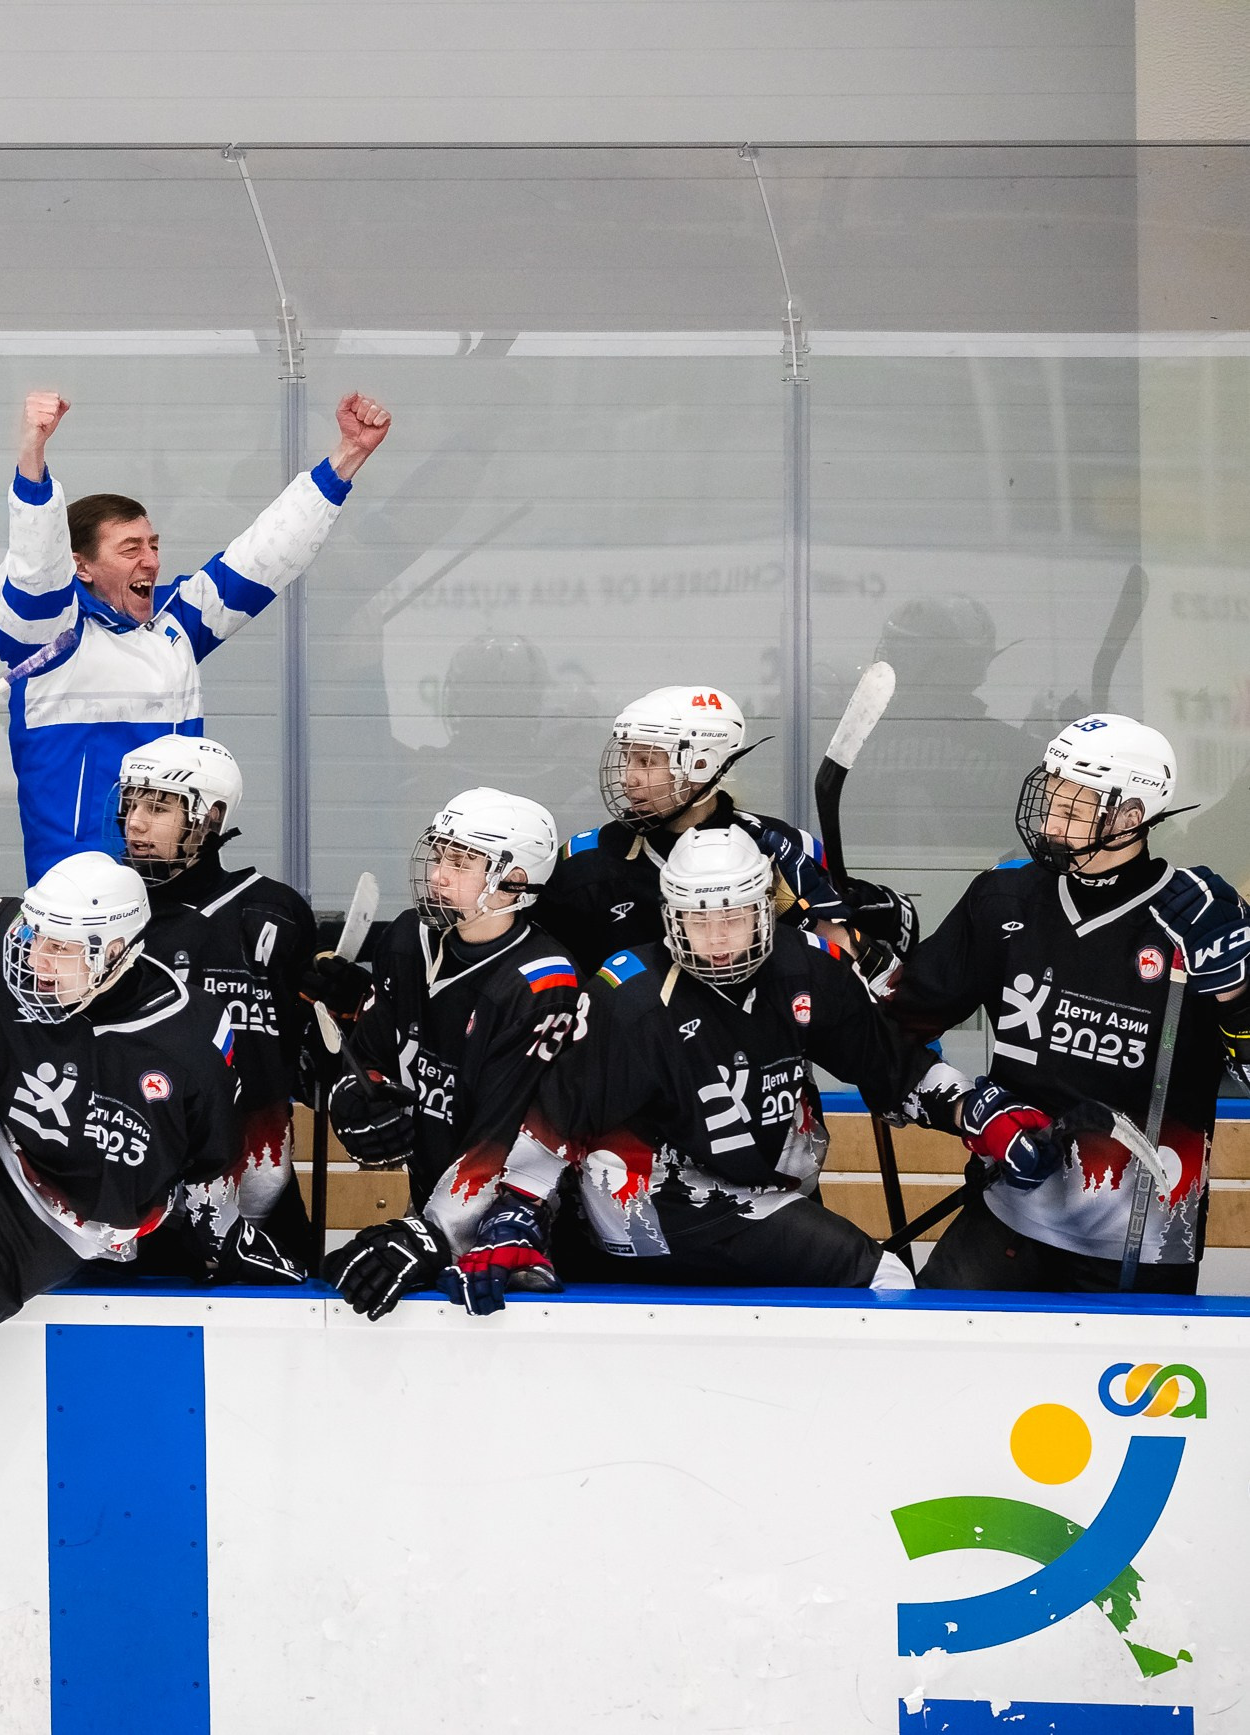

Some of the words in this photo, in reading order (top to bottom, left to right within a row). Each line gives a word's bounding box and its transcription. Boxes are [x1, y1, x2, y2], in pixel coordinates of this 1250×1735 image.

[692, 693, 722, 710] 44
[1048, 747, 1069, 761] CCM
[129, 763, 155, 772] CCM
[1132, 776, 1161, 788] CCM
[694, 885, 730, 894] BAUER
[203, 977, 248, 995] Дети
[1055, 999, 1102, 1023] Дети
[1105, 1012, 1149, 1035] Азии
[1050, 1021, 1147, 1069] 2023
[762, 1072, 789, 1093] Дети
